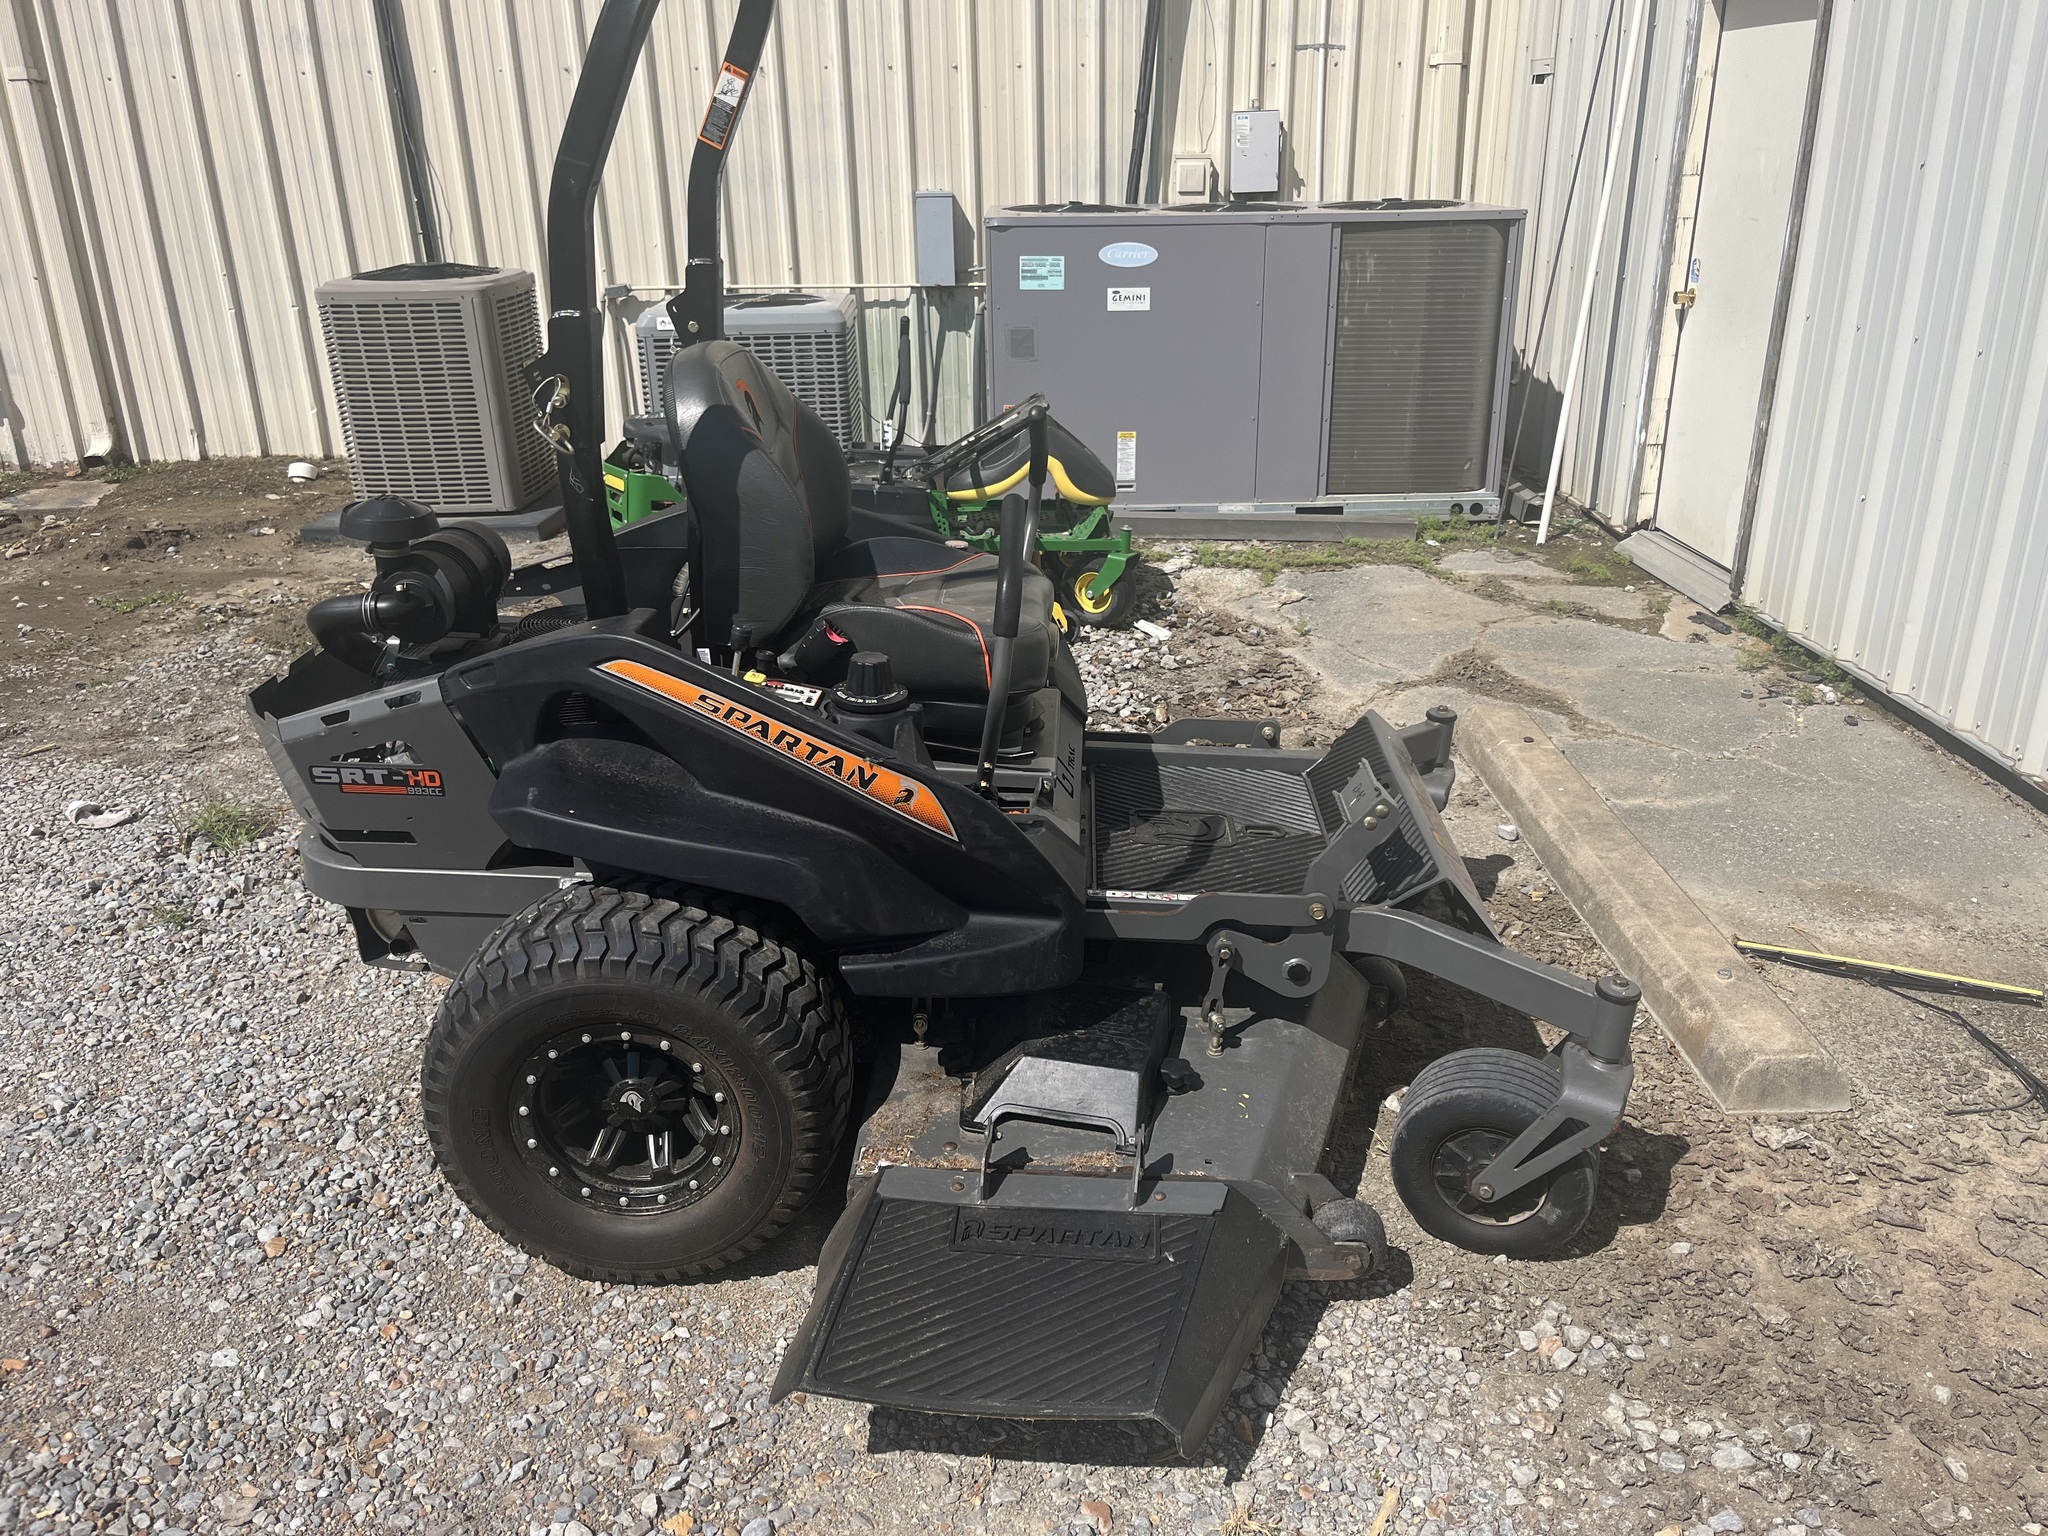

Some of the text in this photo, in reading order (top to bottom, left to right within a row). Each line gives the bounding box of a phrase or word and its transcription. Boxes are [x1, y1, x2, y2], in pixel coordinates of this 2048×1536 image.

[1107, 248, 1150, 259] Carrier
[1112, 294, 1146, 302] GEMINI
[694, 694, 879, 791] SPARTAN
[312, 766, 442, 787] SRT-HD
[407, 787, 443, 796] 993CC
[986, 1225, 1150, 1249] SPARTAN
